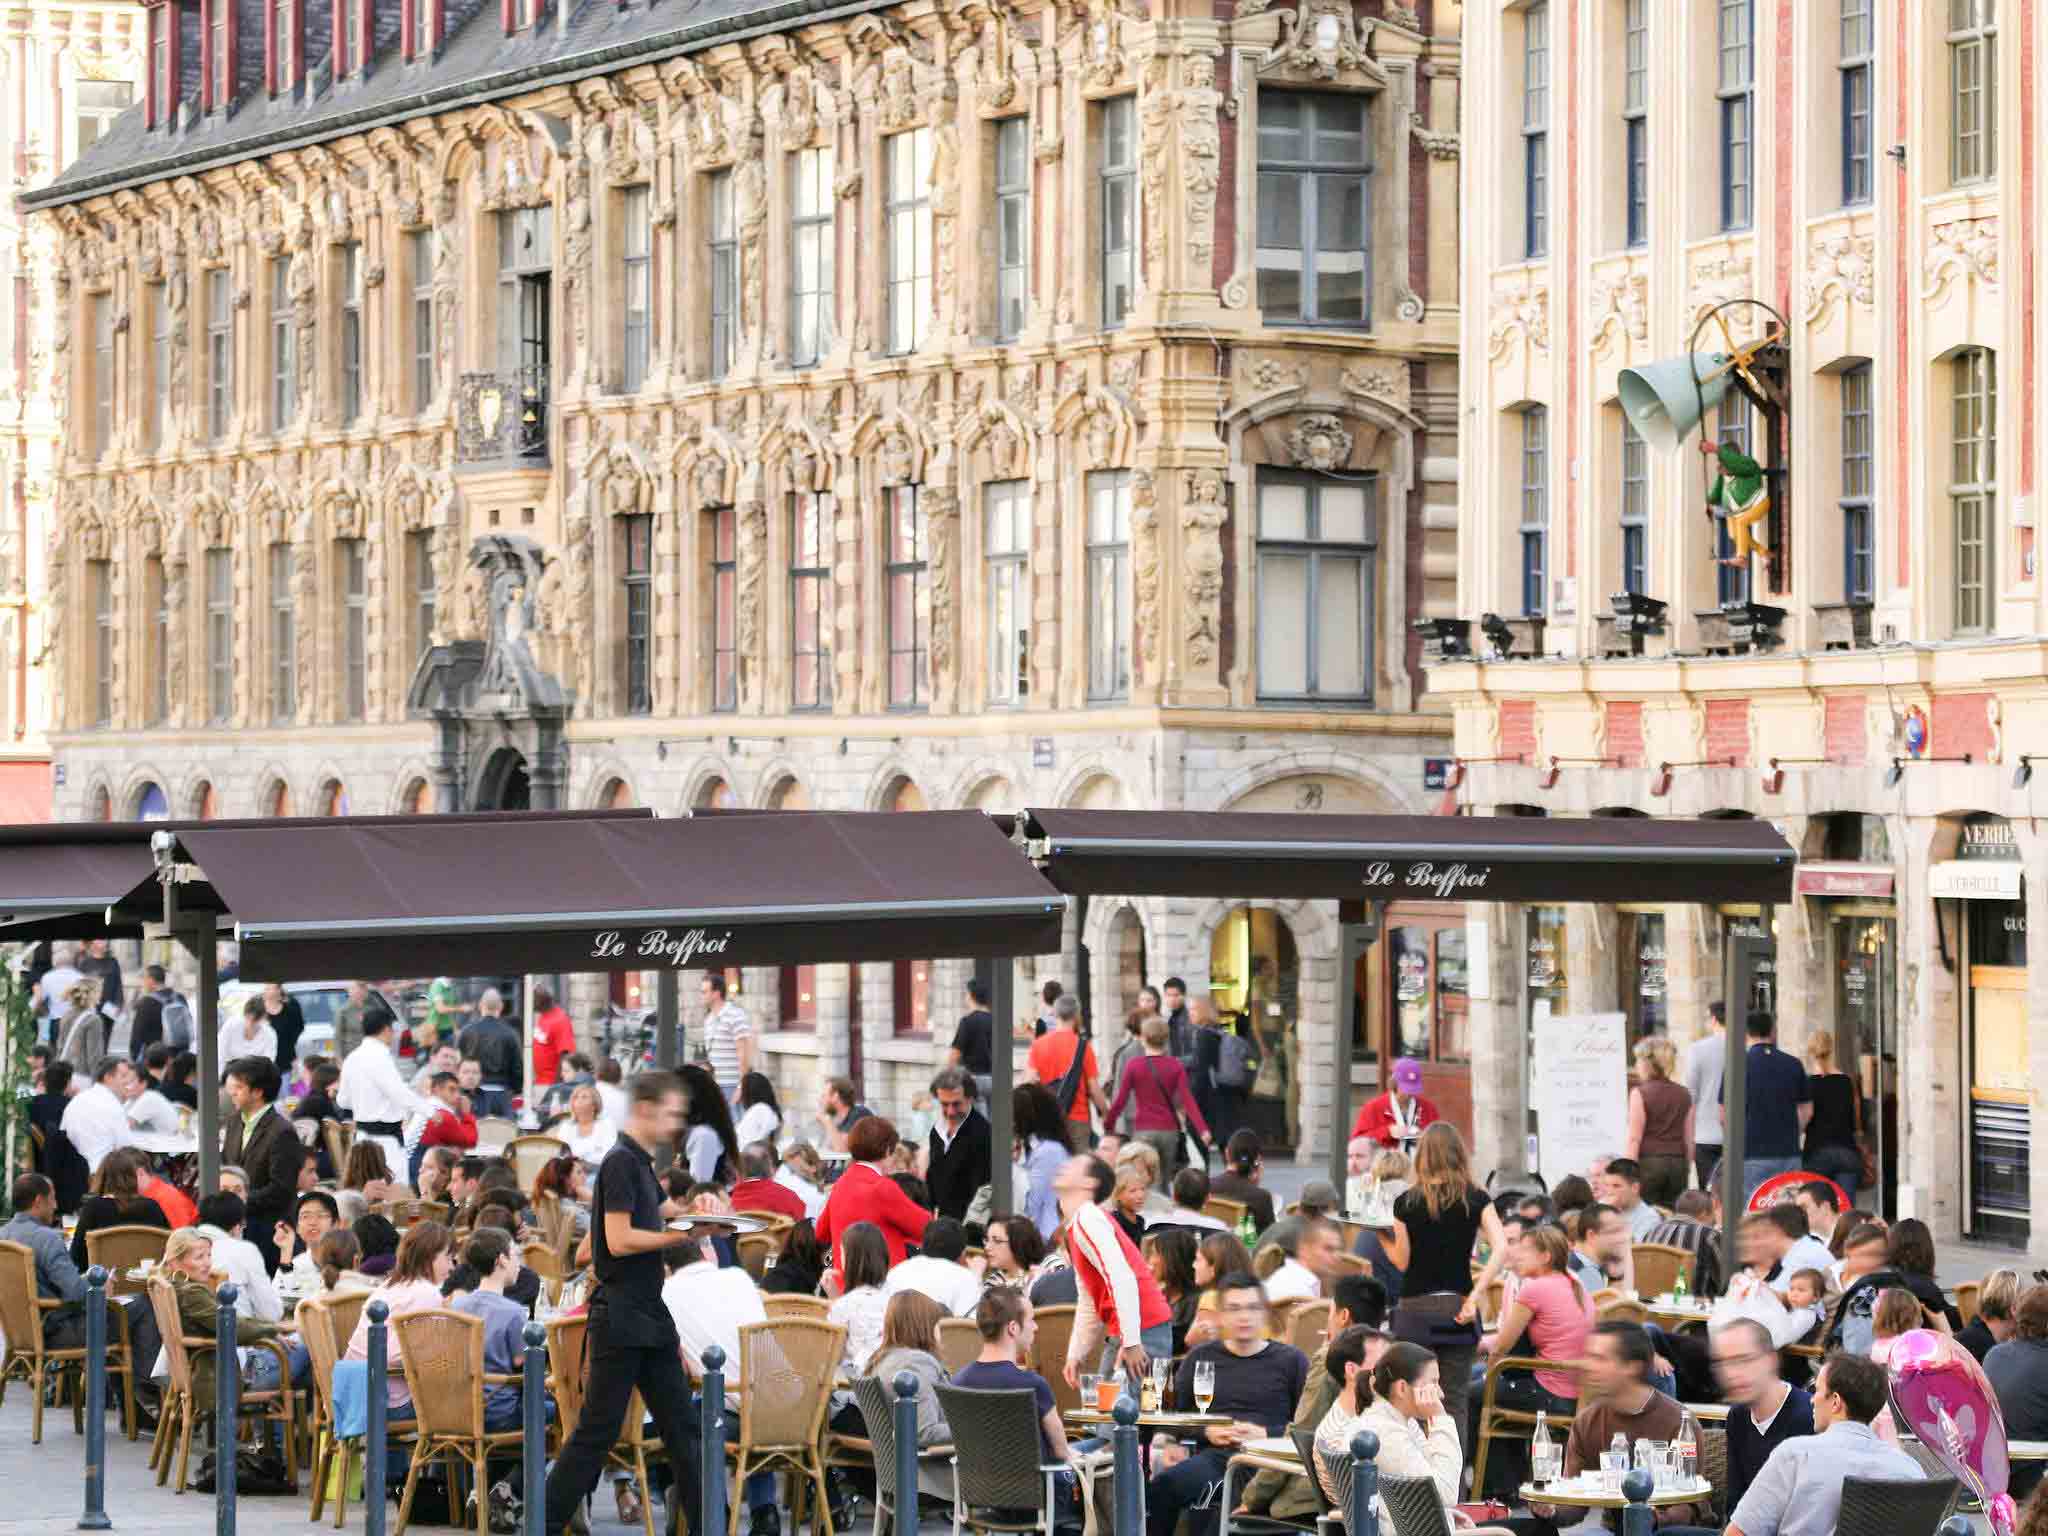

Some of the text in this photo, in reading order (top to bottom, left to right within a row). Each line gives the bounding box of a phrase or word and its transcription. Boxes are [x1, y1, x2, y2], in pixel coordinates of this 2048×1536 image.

[1362, 861, 1491, 897] Le Beffroi
[591, 928, 732, 966] Le Beffroi
